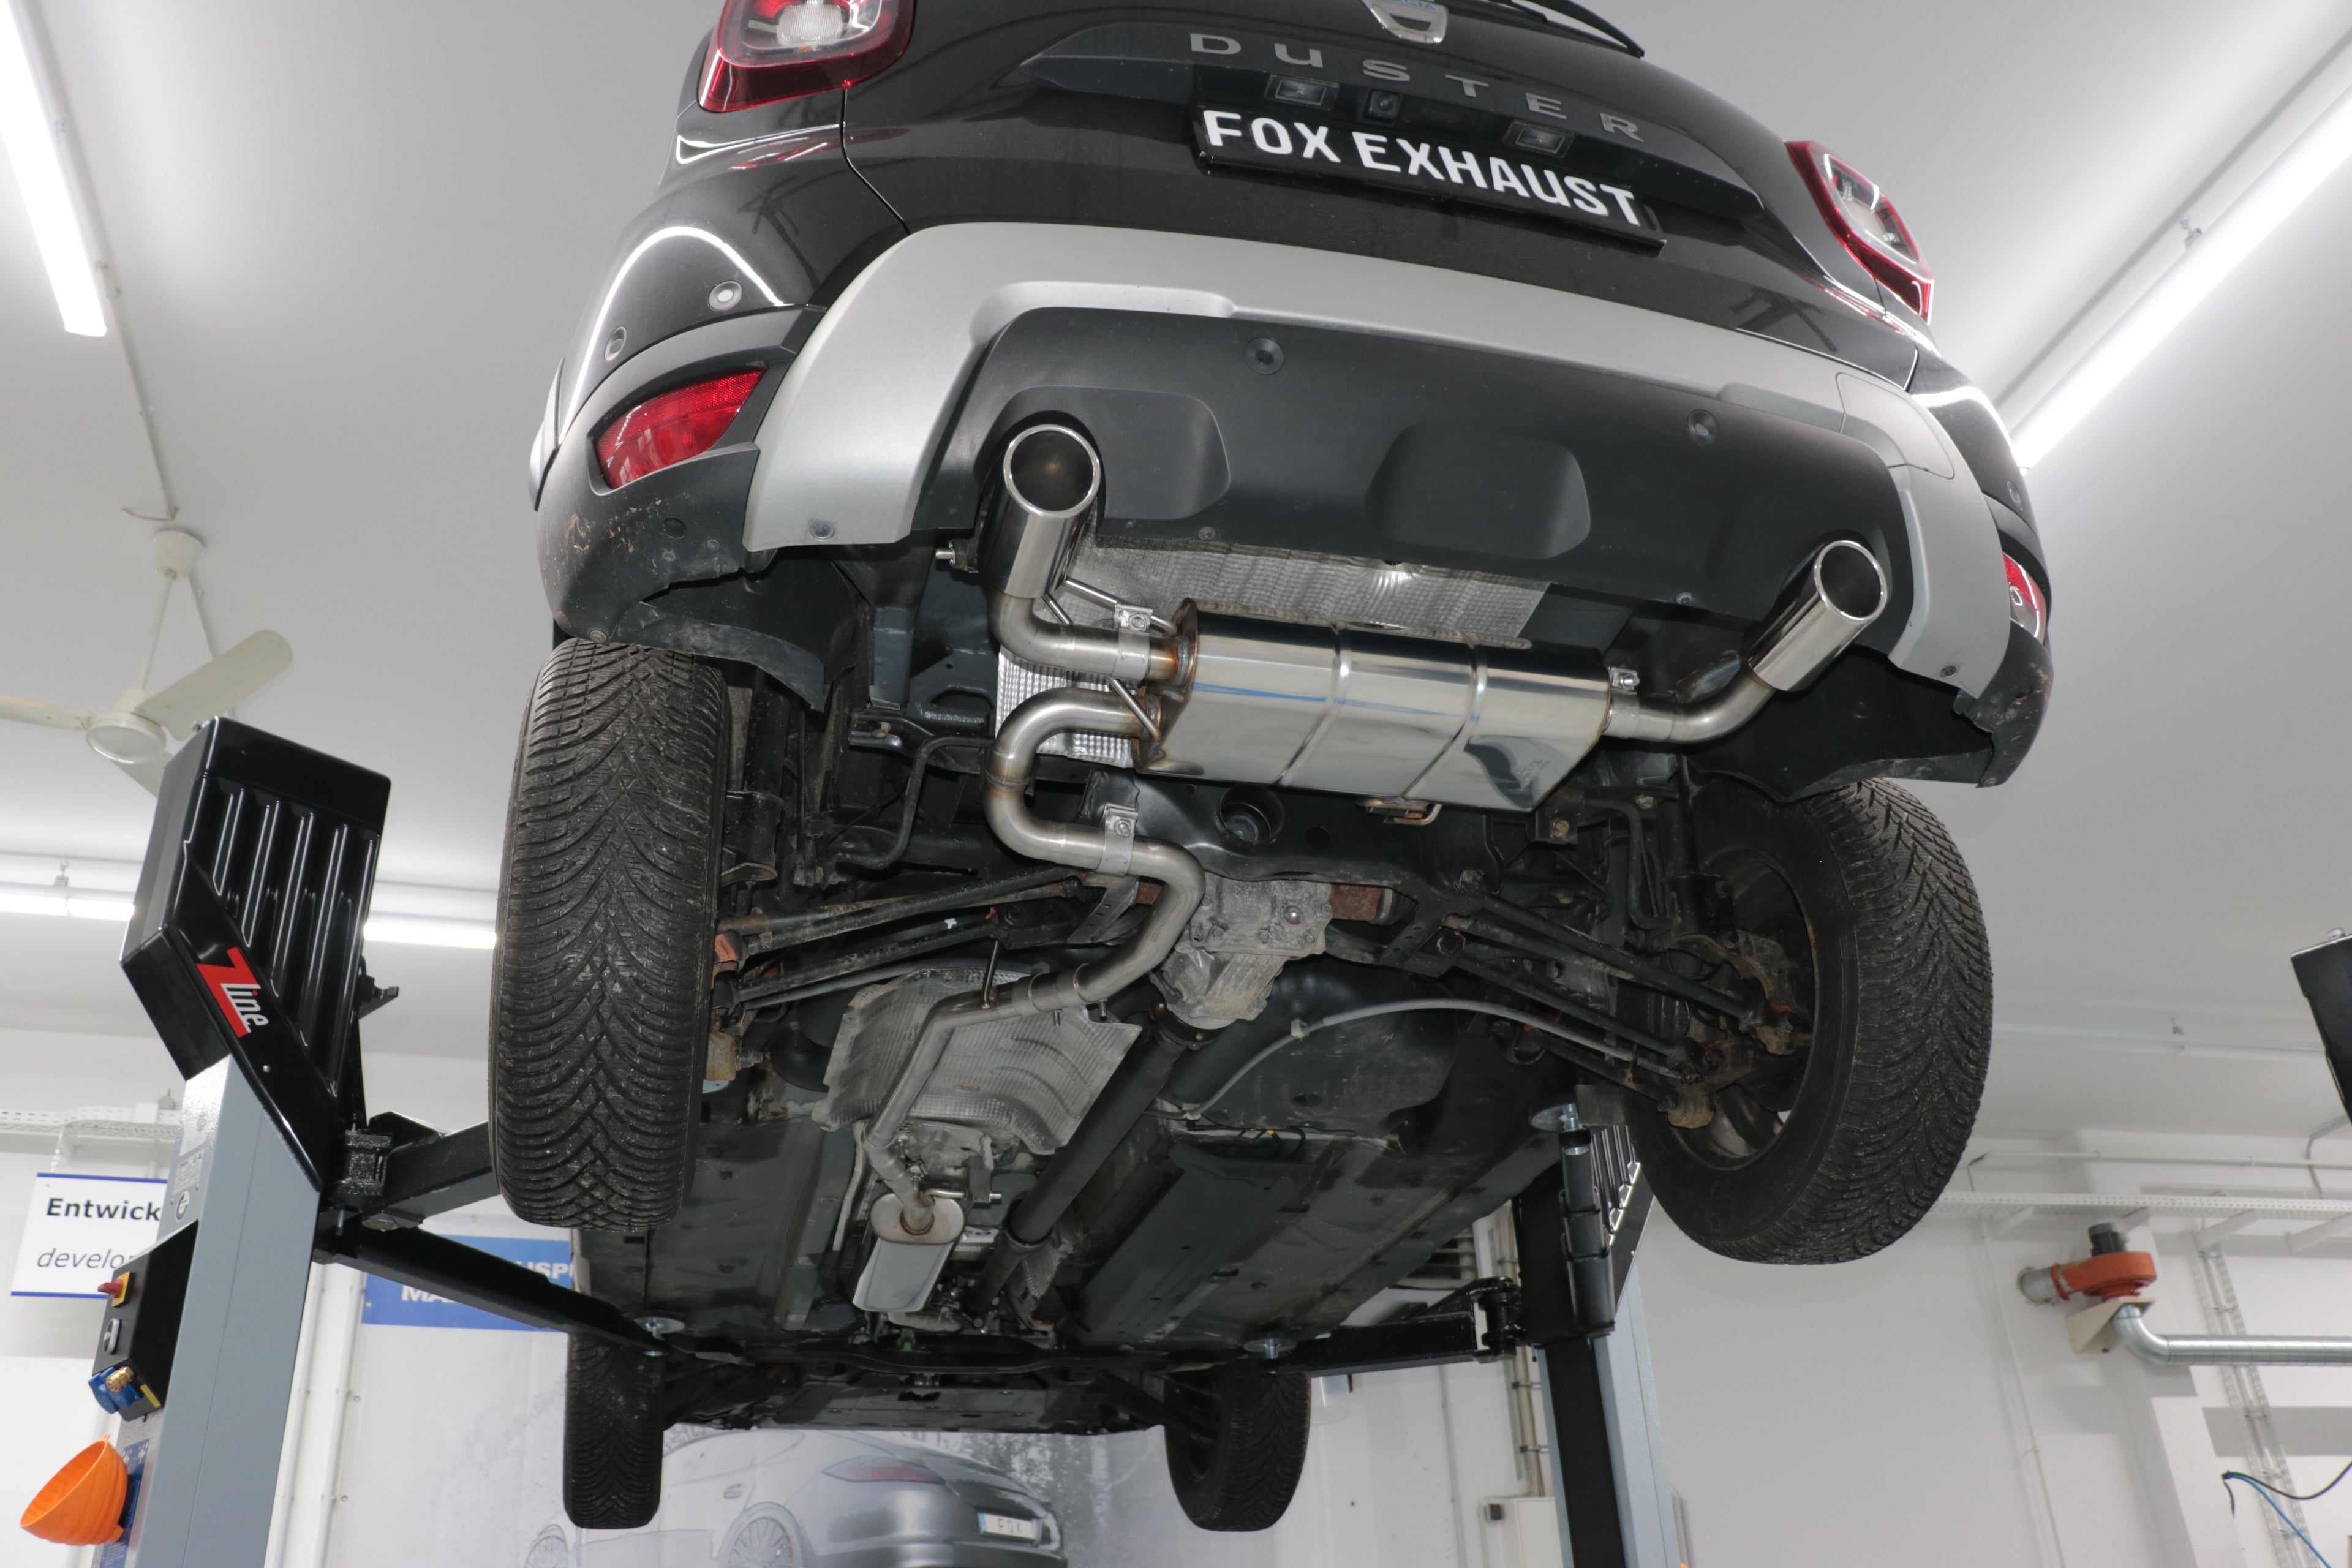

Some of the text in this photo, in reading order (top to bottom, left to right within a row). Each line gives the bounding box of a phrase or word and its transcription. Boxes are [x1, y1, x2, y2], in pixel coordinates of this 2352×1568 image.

[1190, 33, 1643, 142] DUSTER
[1203, 110, 1640, 226] FOX EXHAUST
[47, 1197, 160, 1221] Entwick
[37, 1248, 133, 1269] develo
